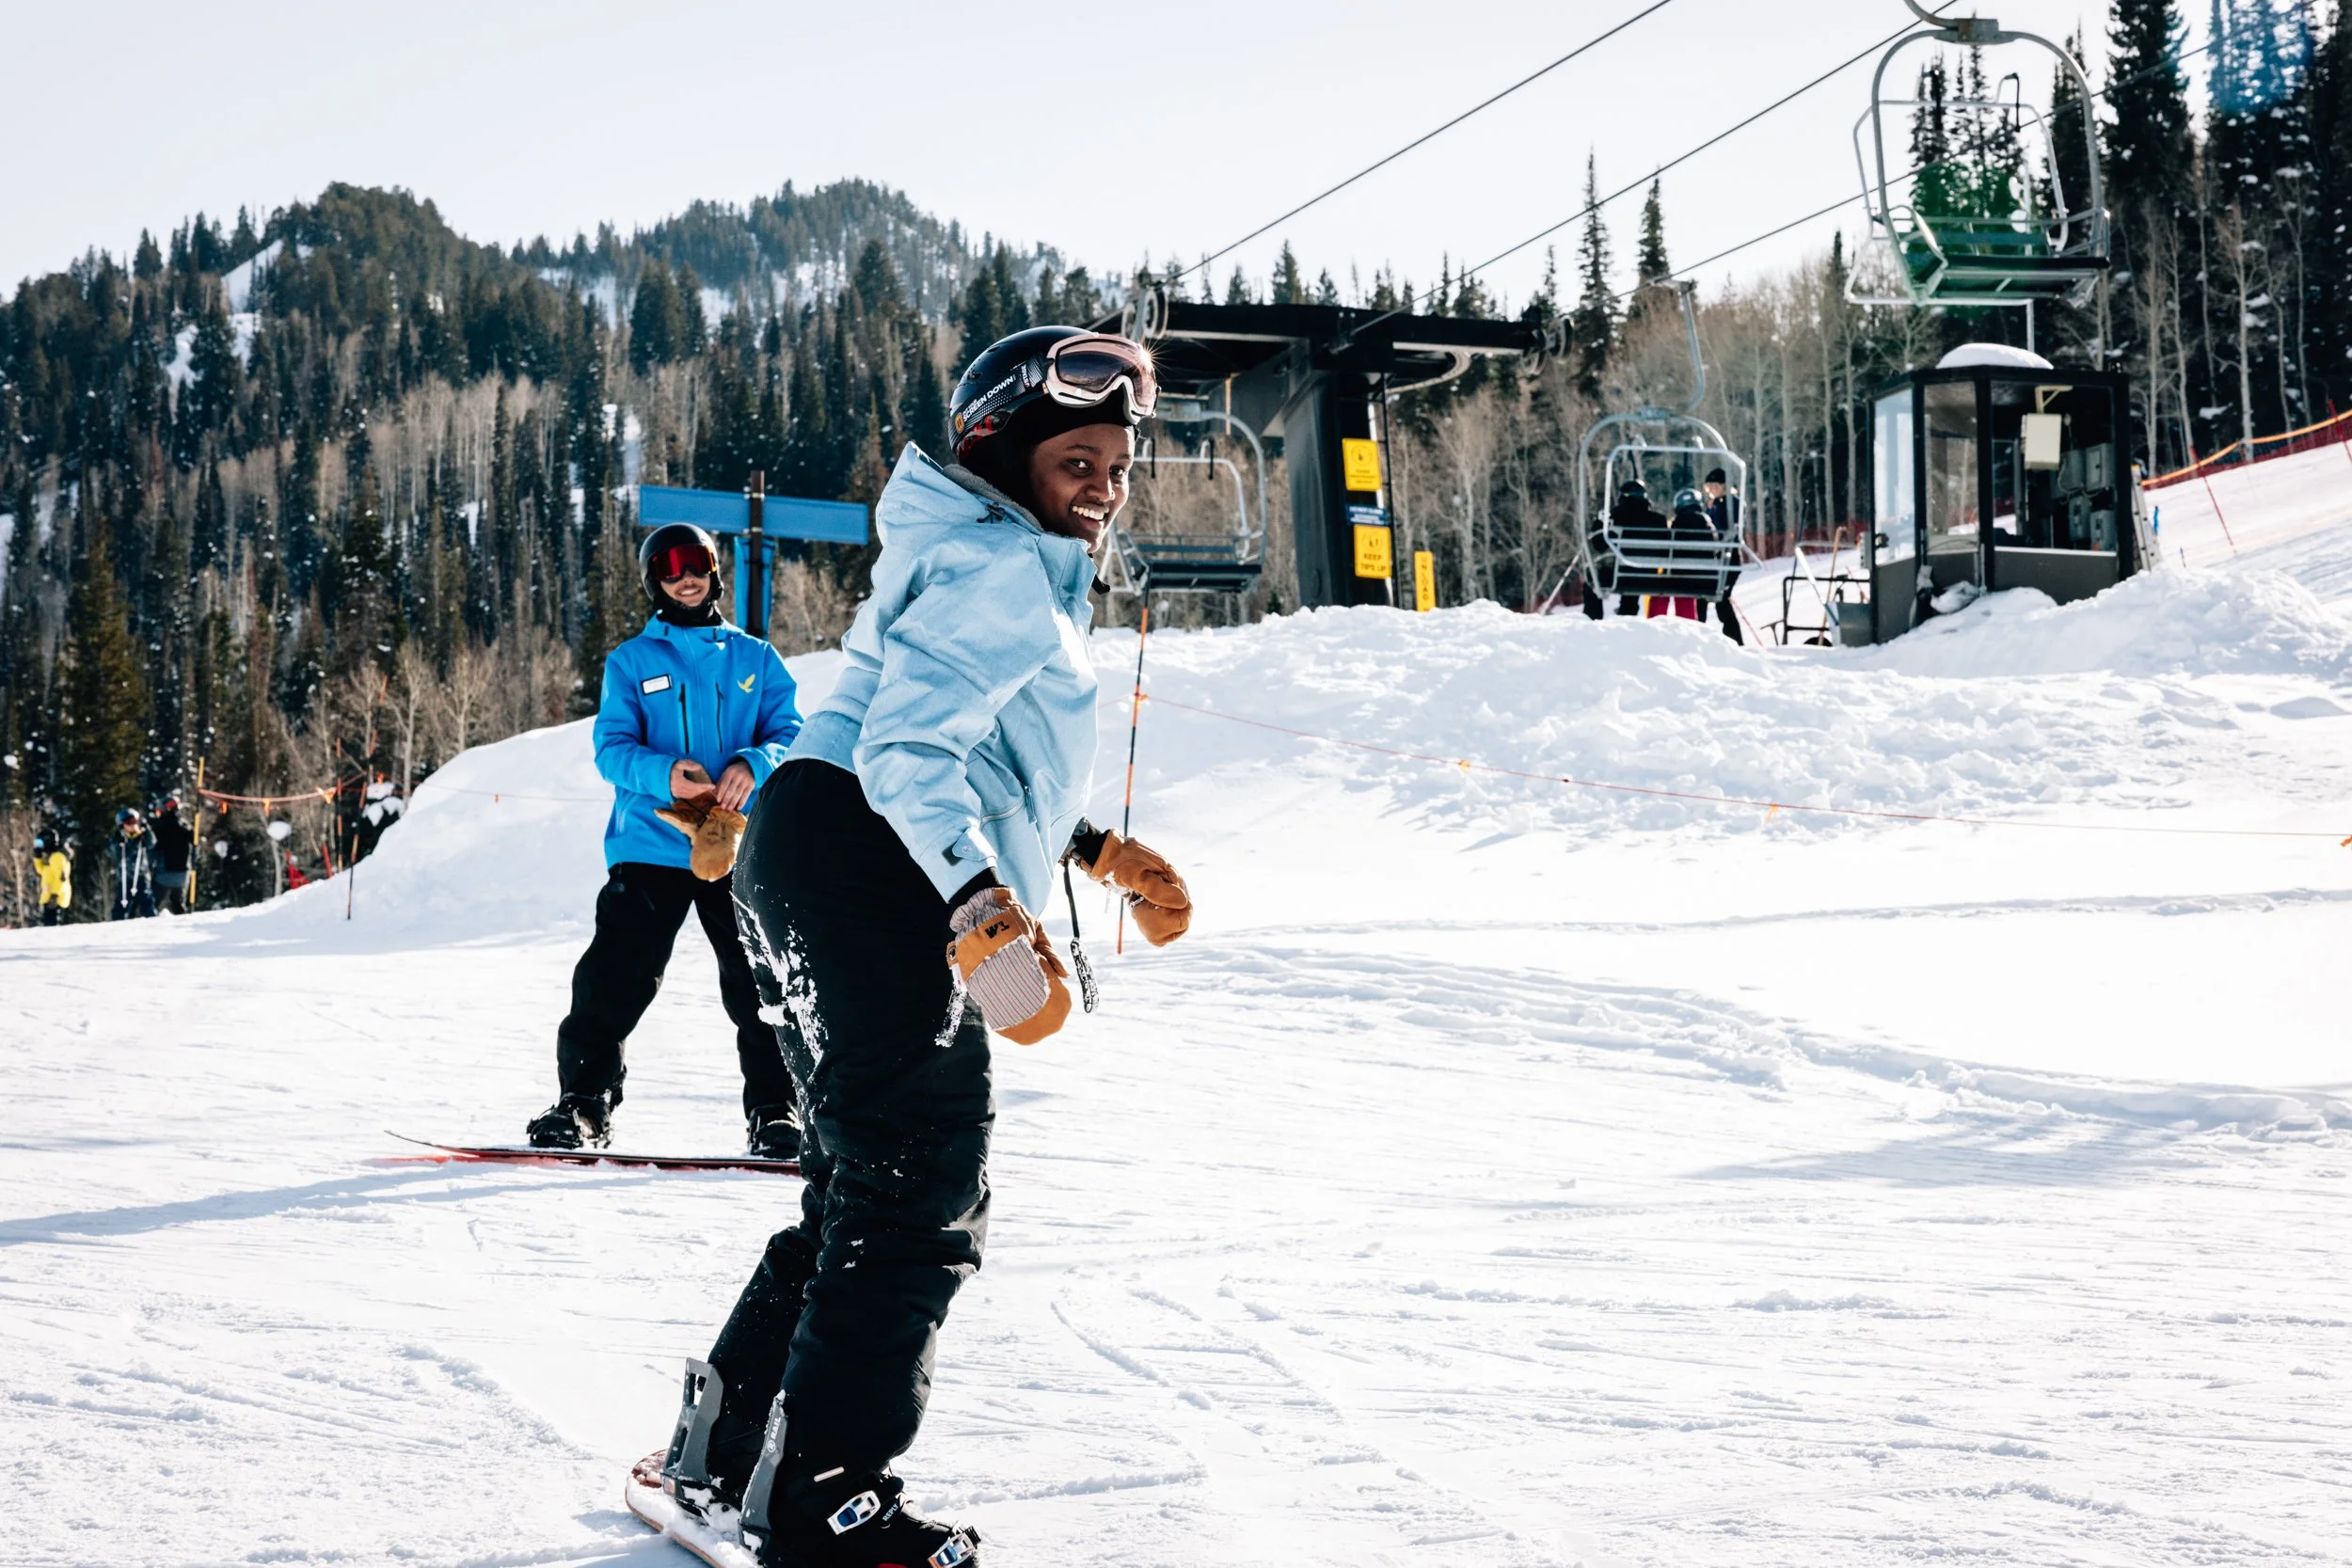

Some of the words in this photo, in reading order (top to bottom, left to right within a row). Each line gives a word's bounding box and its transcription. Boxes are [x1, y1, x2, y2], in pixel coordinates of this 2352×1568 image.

[962, 395, 988, 421] SCREEN
[987, 375, 1014, 399] DOWN
[771, 1417, 781, 1440] RAIL
[882, 1503, 898, 1521] REPLY
